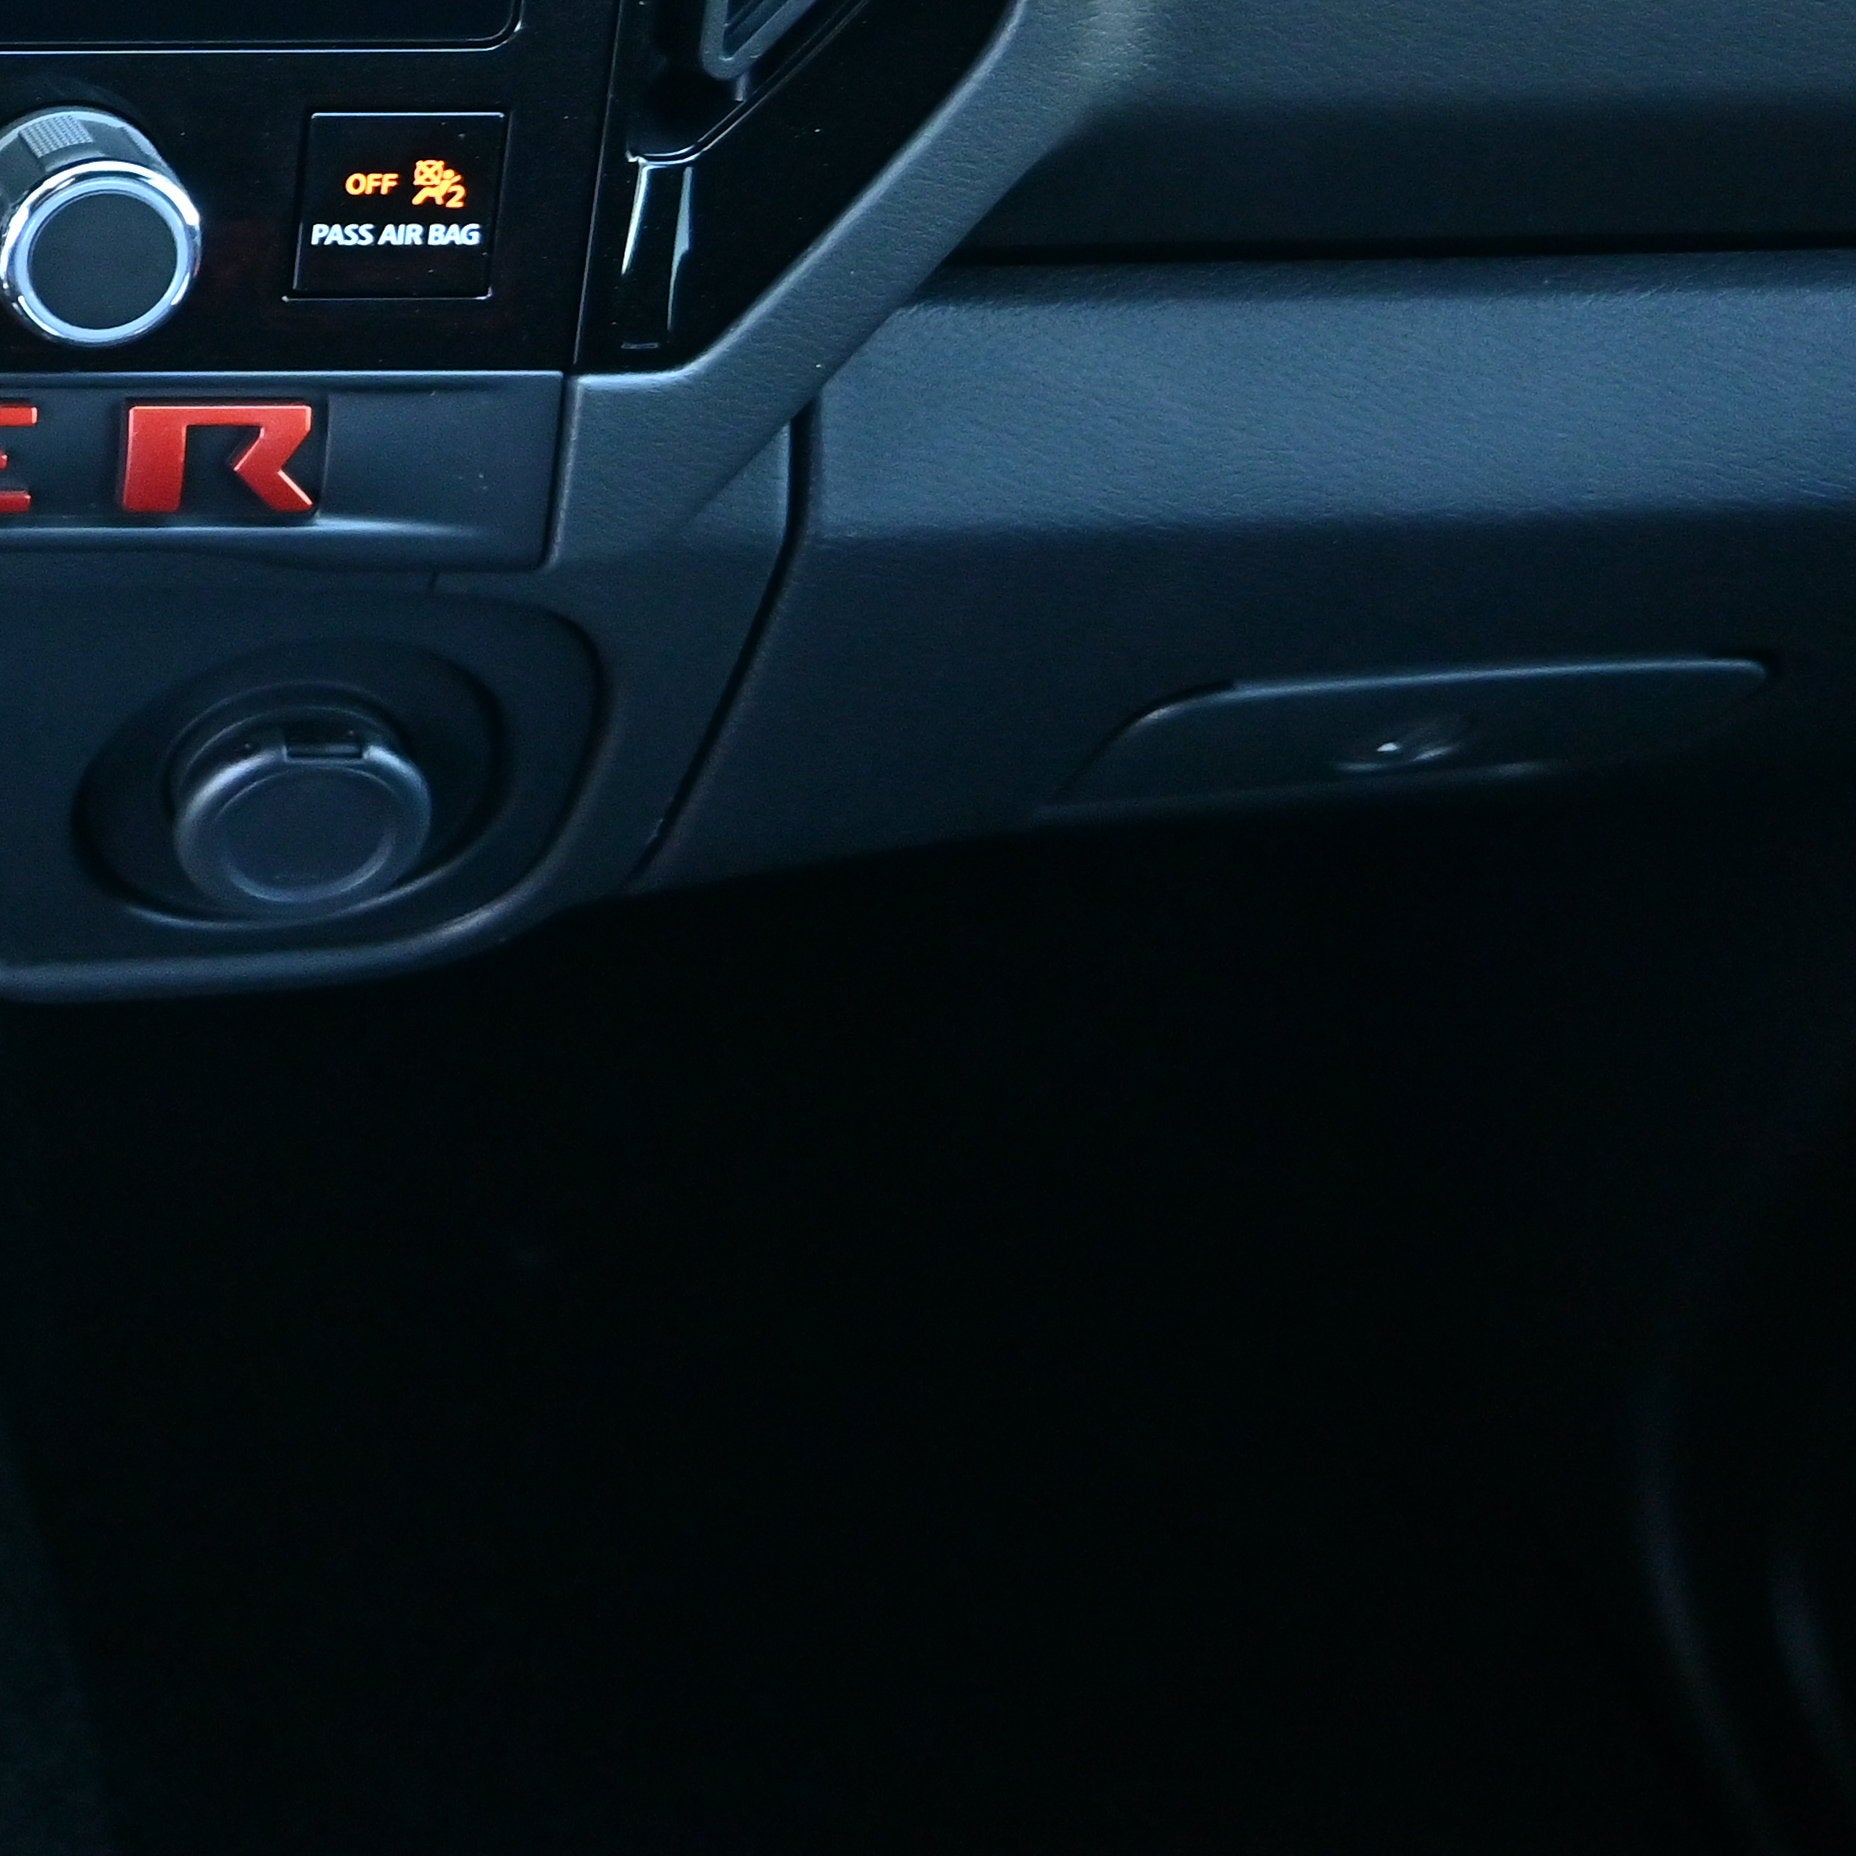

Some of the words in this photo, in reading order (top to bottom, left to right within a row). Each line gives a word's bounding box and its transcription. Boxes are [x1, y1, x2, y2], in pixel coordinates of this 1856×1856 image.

[345, 172, 400, 196] OFF
[310, 223, 376, 246] PASS
[377, 223, 424, 246] AIR
[427, 223, 481, 246] BAG
